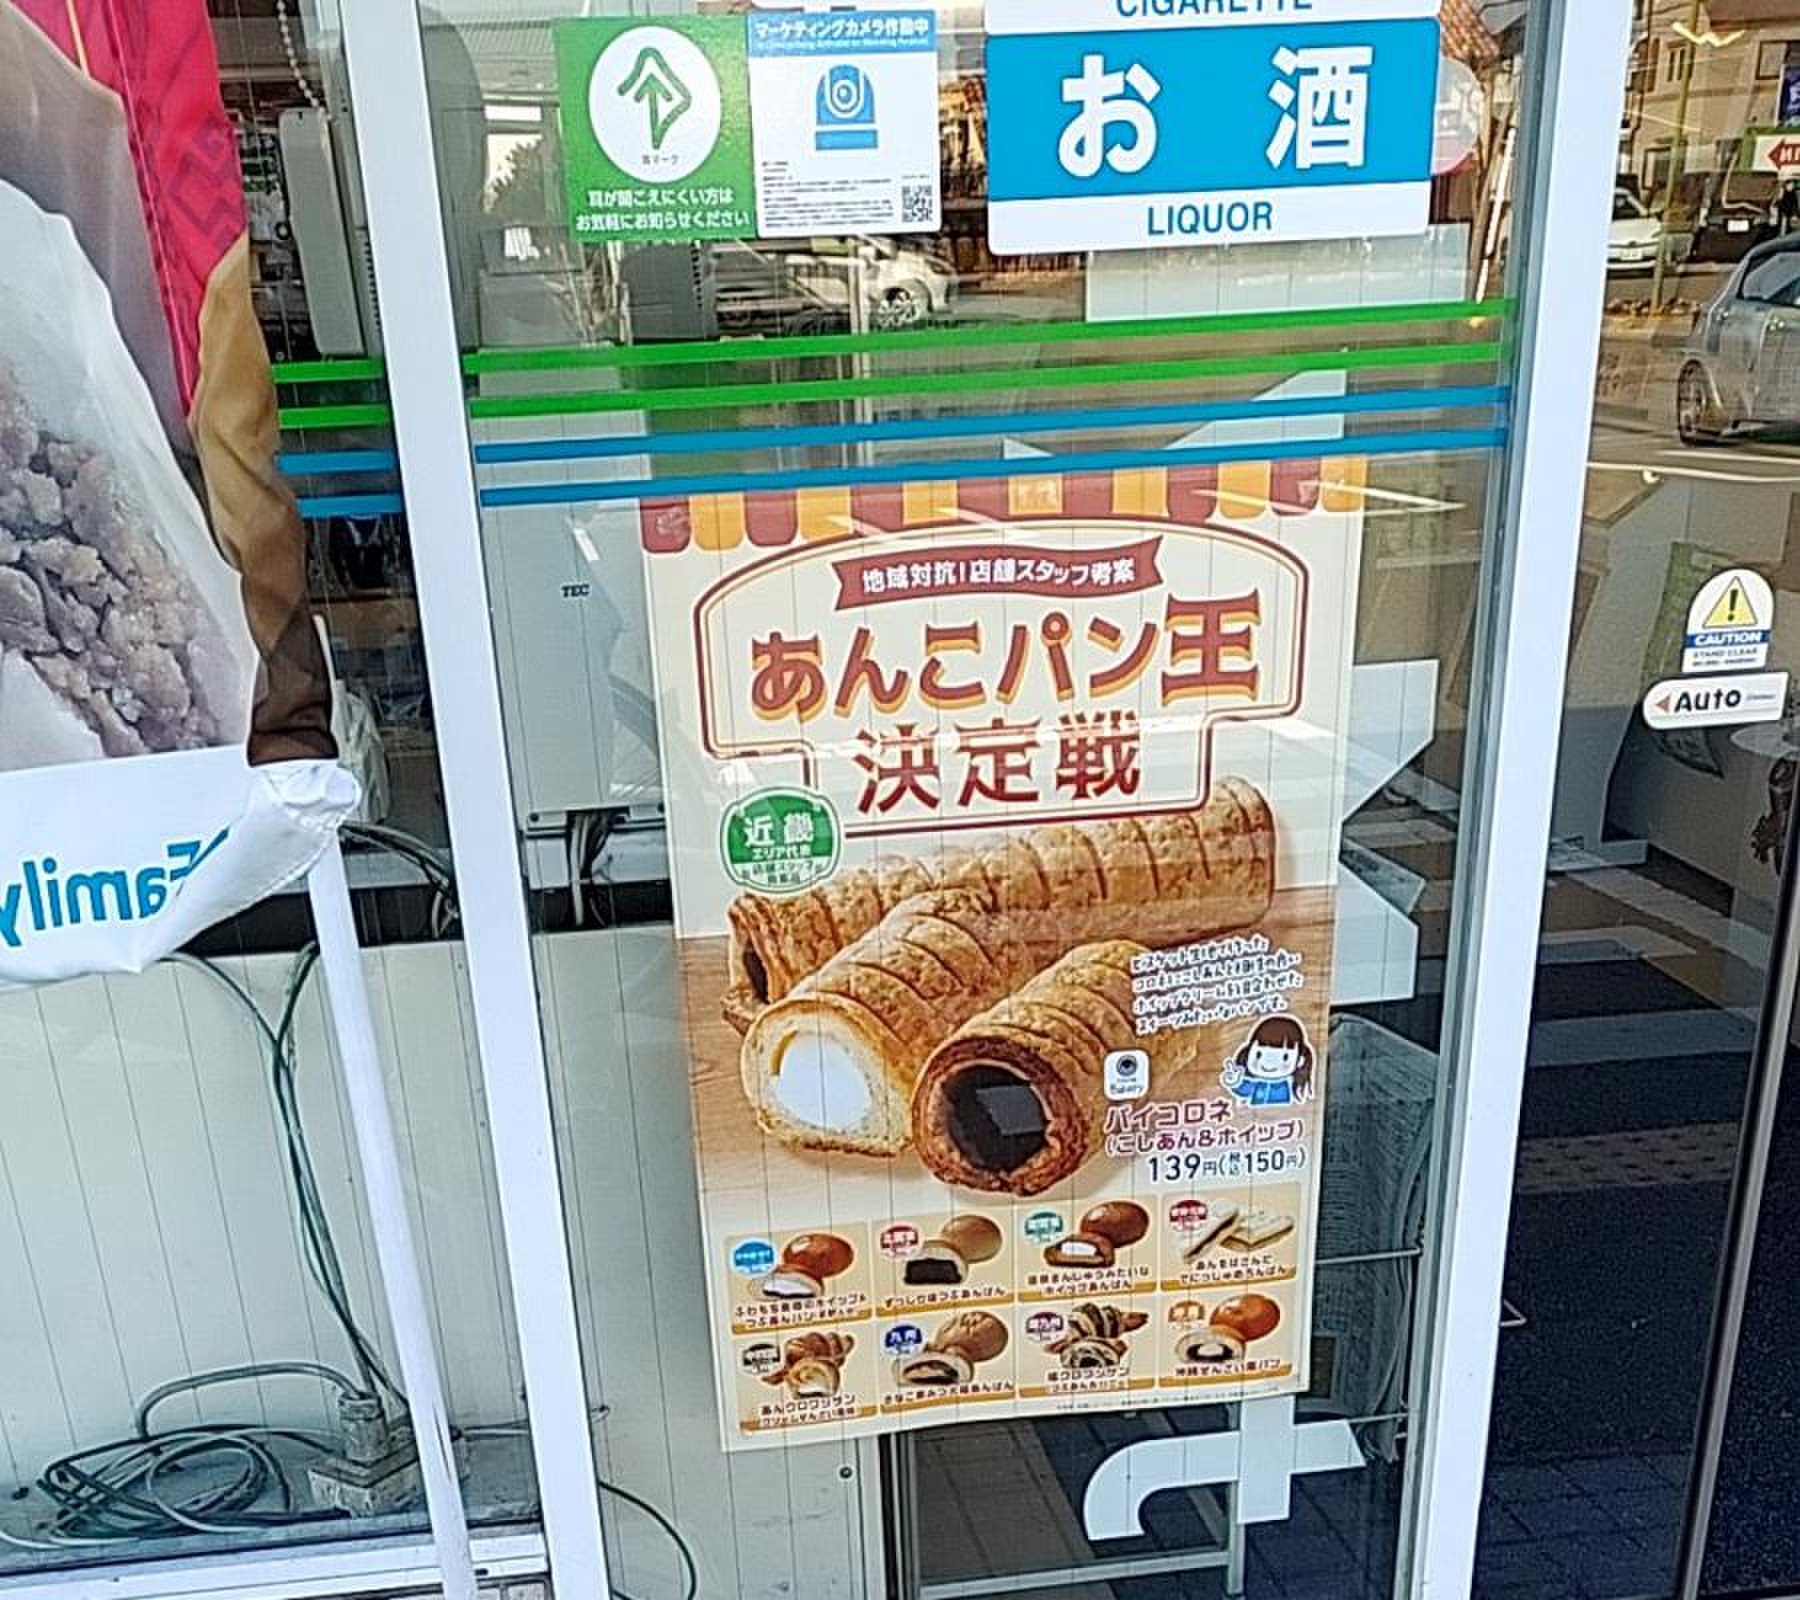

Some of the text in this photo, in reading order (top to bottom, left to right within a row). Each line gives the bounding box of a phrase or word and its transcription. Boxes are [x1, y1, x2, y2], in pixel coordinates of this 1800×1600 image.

[588, 187, 735, 207] 耳が聞こえにくい方は
[575, 211, 750, 231] お気軽にお知らせください
[1148, 202, 1273, 236] LIQUOR
[1695, 632, 1761, 646] CAUTION
[749, 590, 1264, 721] あんこパン王
[1674, 688, 1742, 712] Auto
[853, 709, 1142, 814] 決定戦
[743, 812, 815, 847] 近畿
